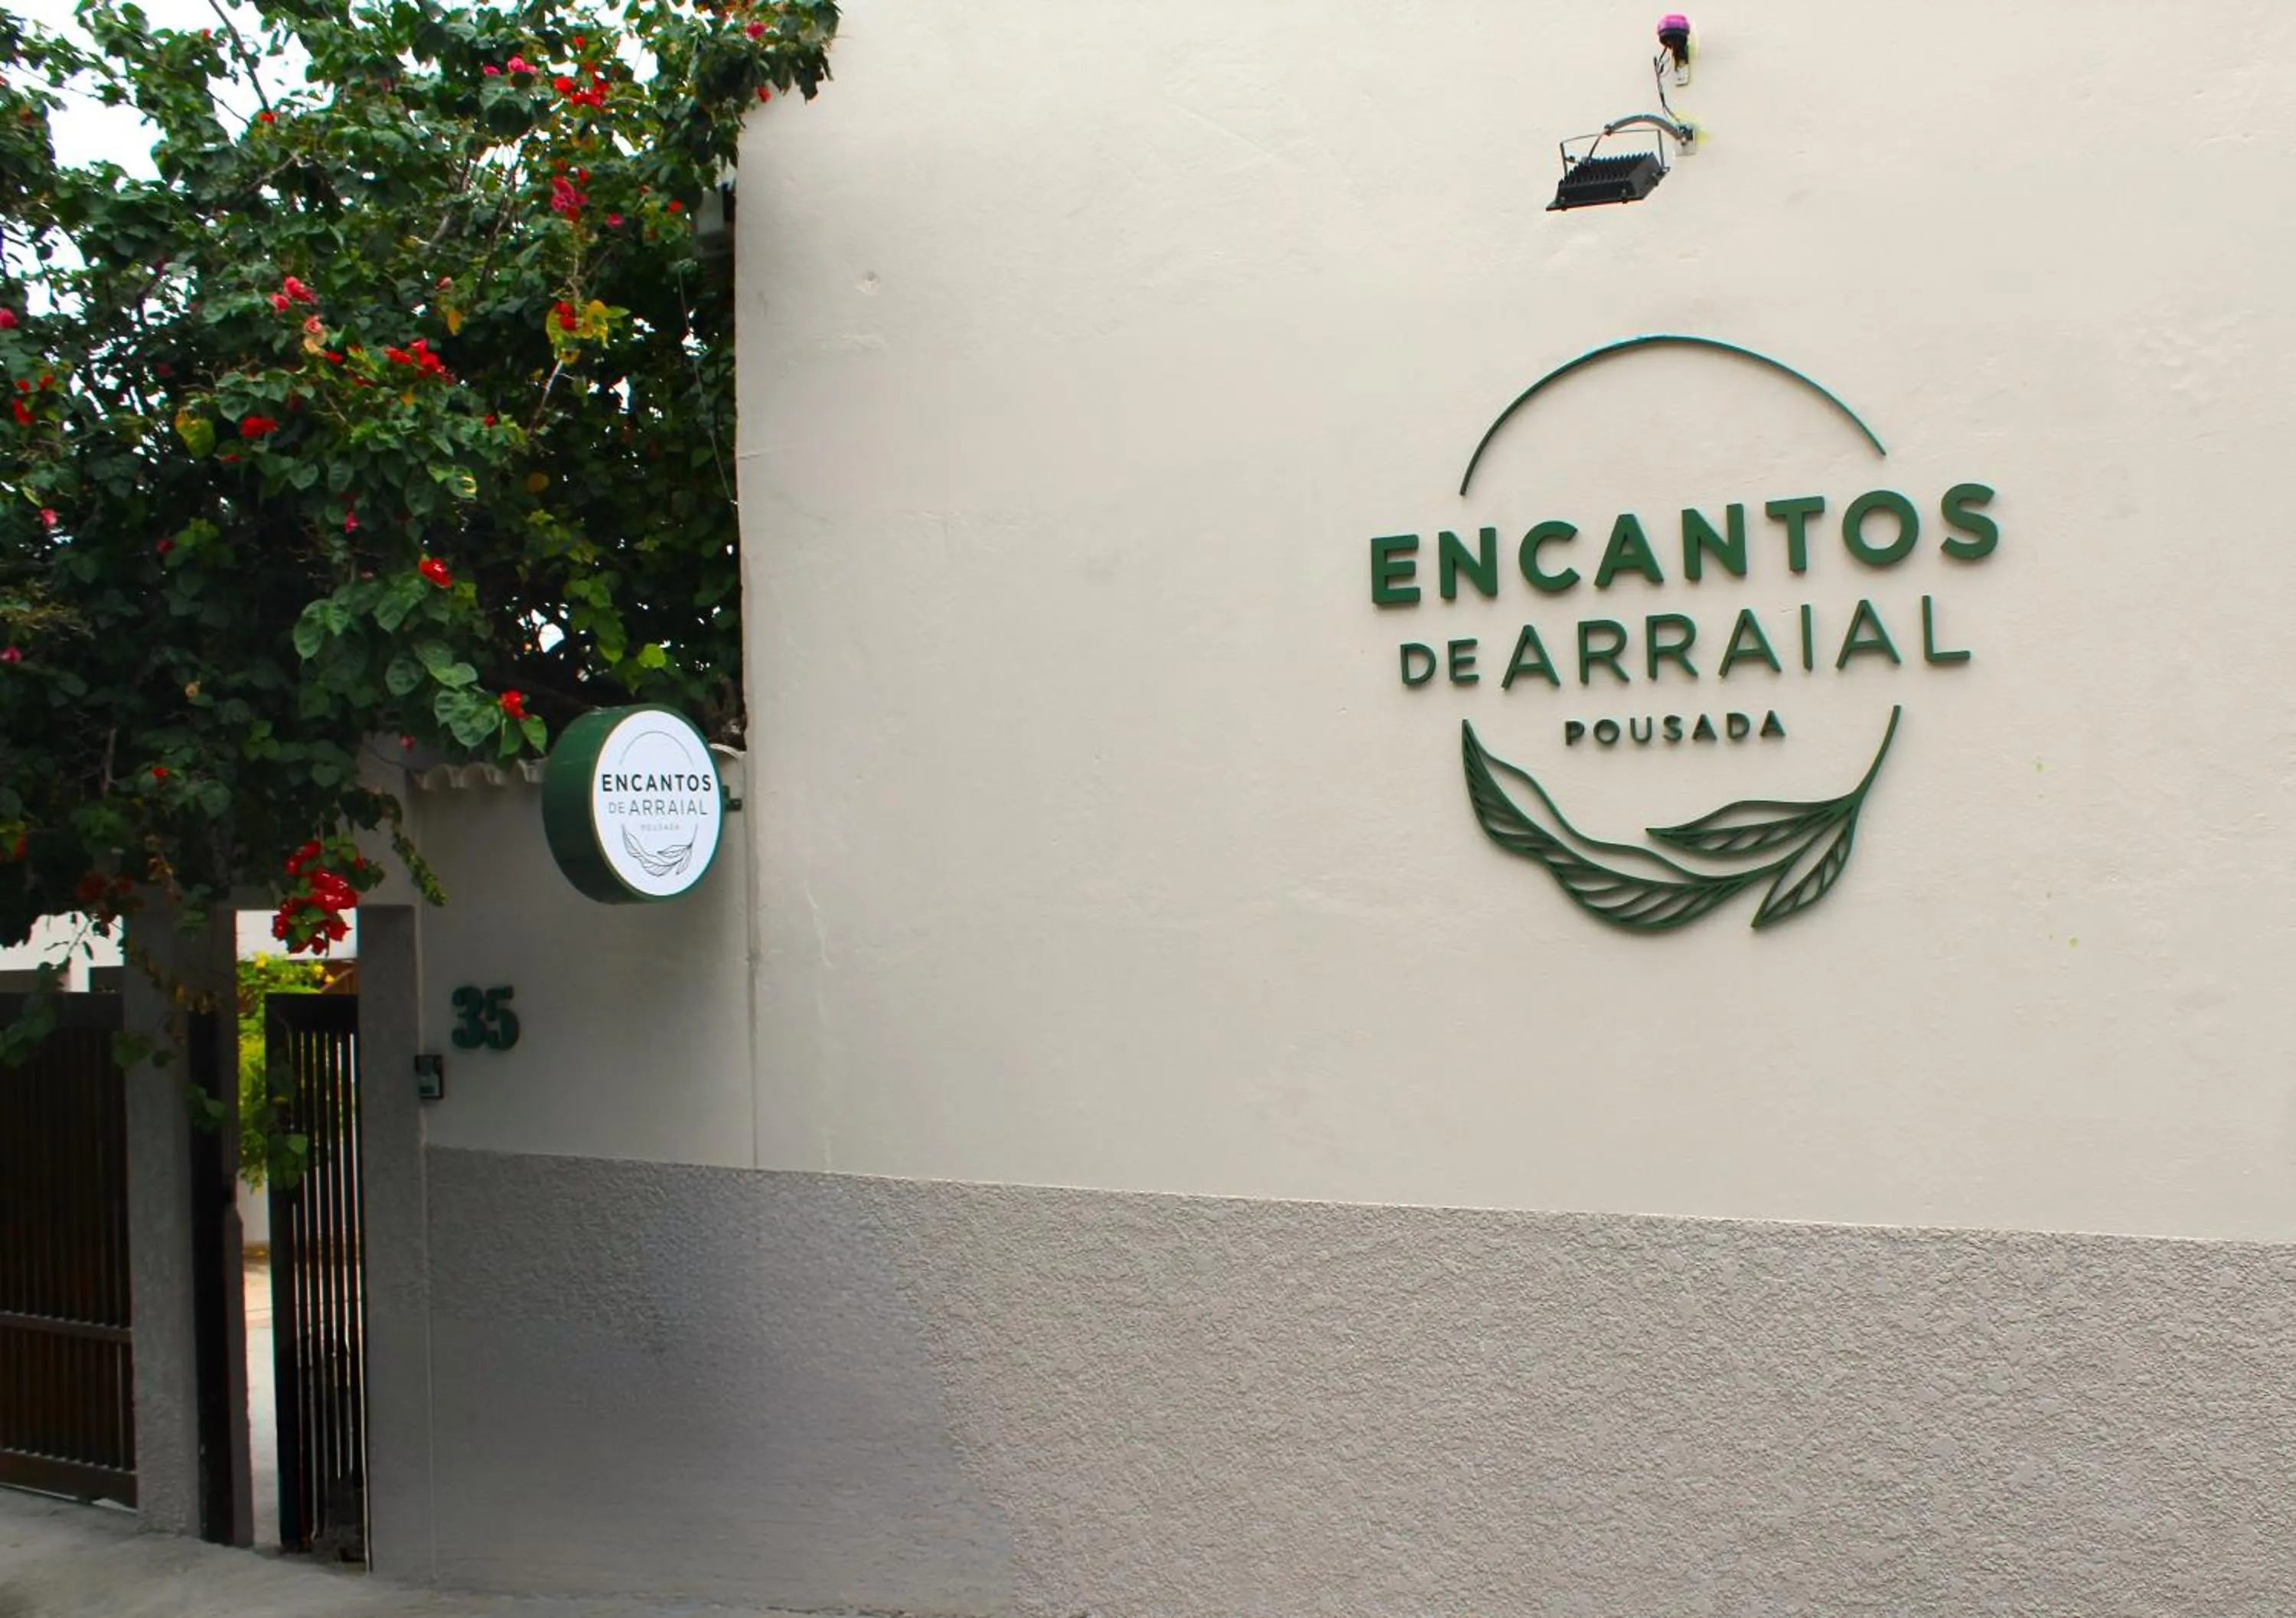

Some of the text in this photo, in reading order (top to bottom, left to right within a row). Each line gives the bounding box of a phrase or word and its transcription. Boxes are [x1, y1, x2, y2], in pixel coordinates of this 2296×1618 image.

[1371, 482, 1999, 605] ENCANTOS
[1399, 595, 1971, 689] DE ARRAIAL
[1564, 709, 1786, 746] POUSADA
[602, 774, 711, 792] ENCANTOS
[608, 799, 708, 815] DE ARRAIAL
[452, 985, 520, 1051] 35
